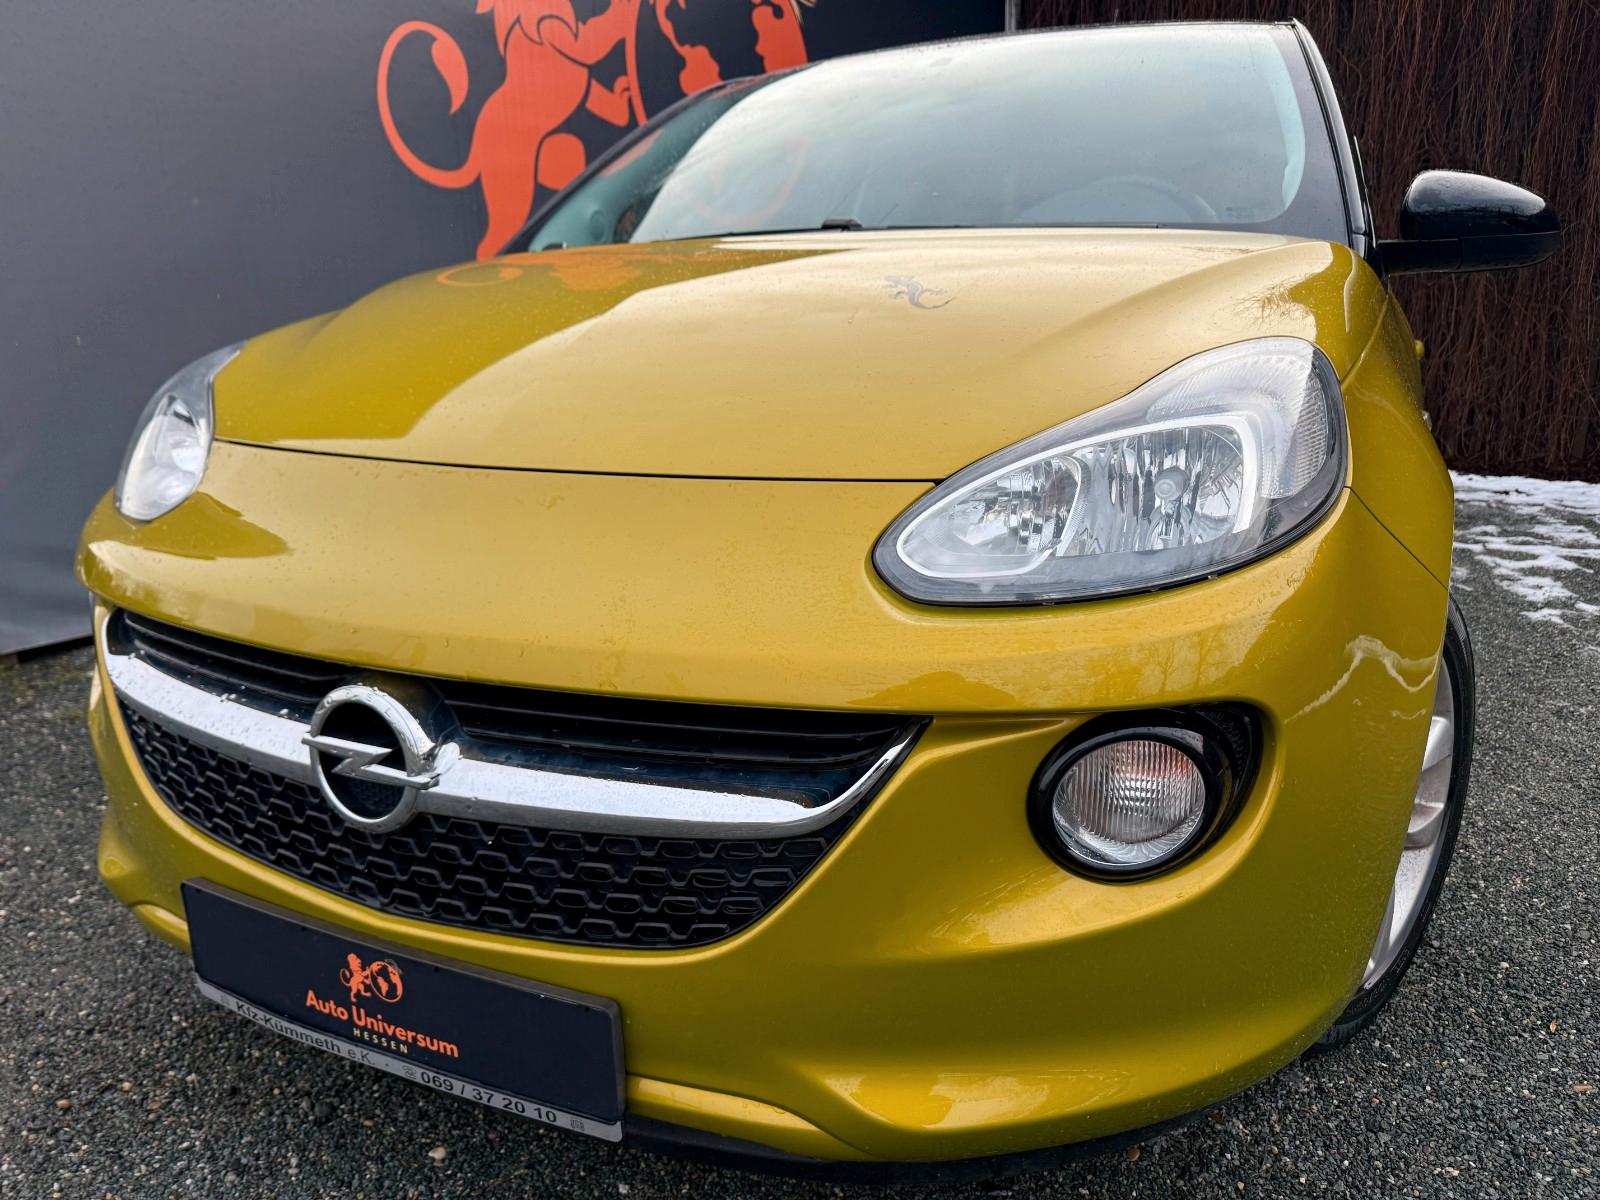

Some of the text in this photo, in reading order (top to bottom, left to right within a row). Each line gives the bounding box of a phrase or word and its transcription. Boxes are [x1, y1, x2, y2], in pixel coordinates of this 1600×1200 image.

[306, 990, 459, 1058] Auto Universum
[353, 1027, 408, 1054] HESSEN
[236, 1001, 341, 1053] Kfz-Kümmeth
[421, 1071, 453, 1091] 069
[472, 1088, 494, 1104] 37
[502, 1098, 525, 1113] 20
[534, 1107, 557, 1123] 10
